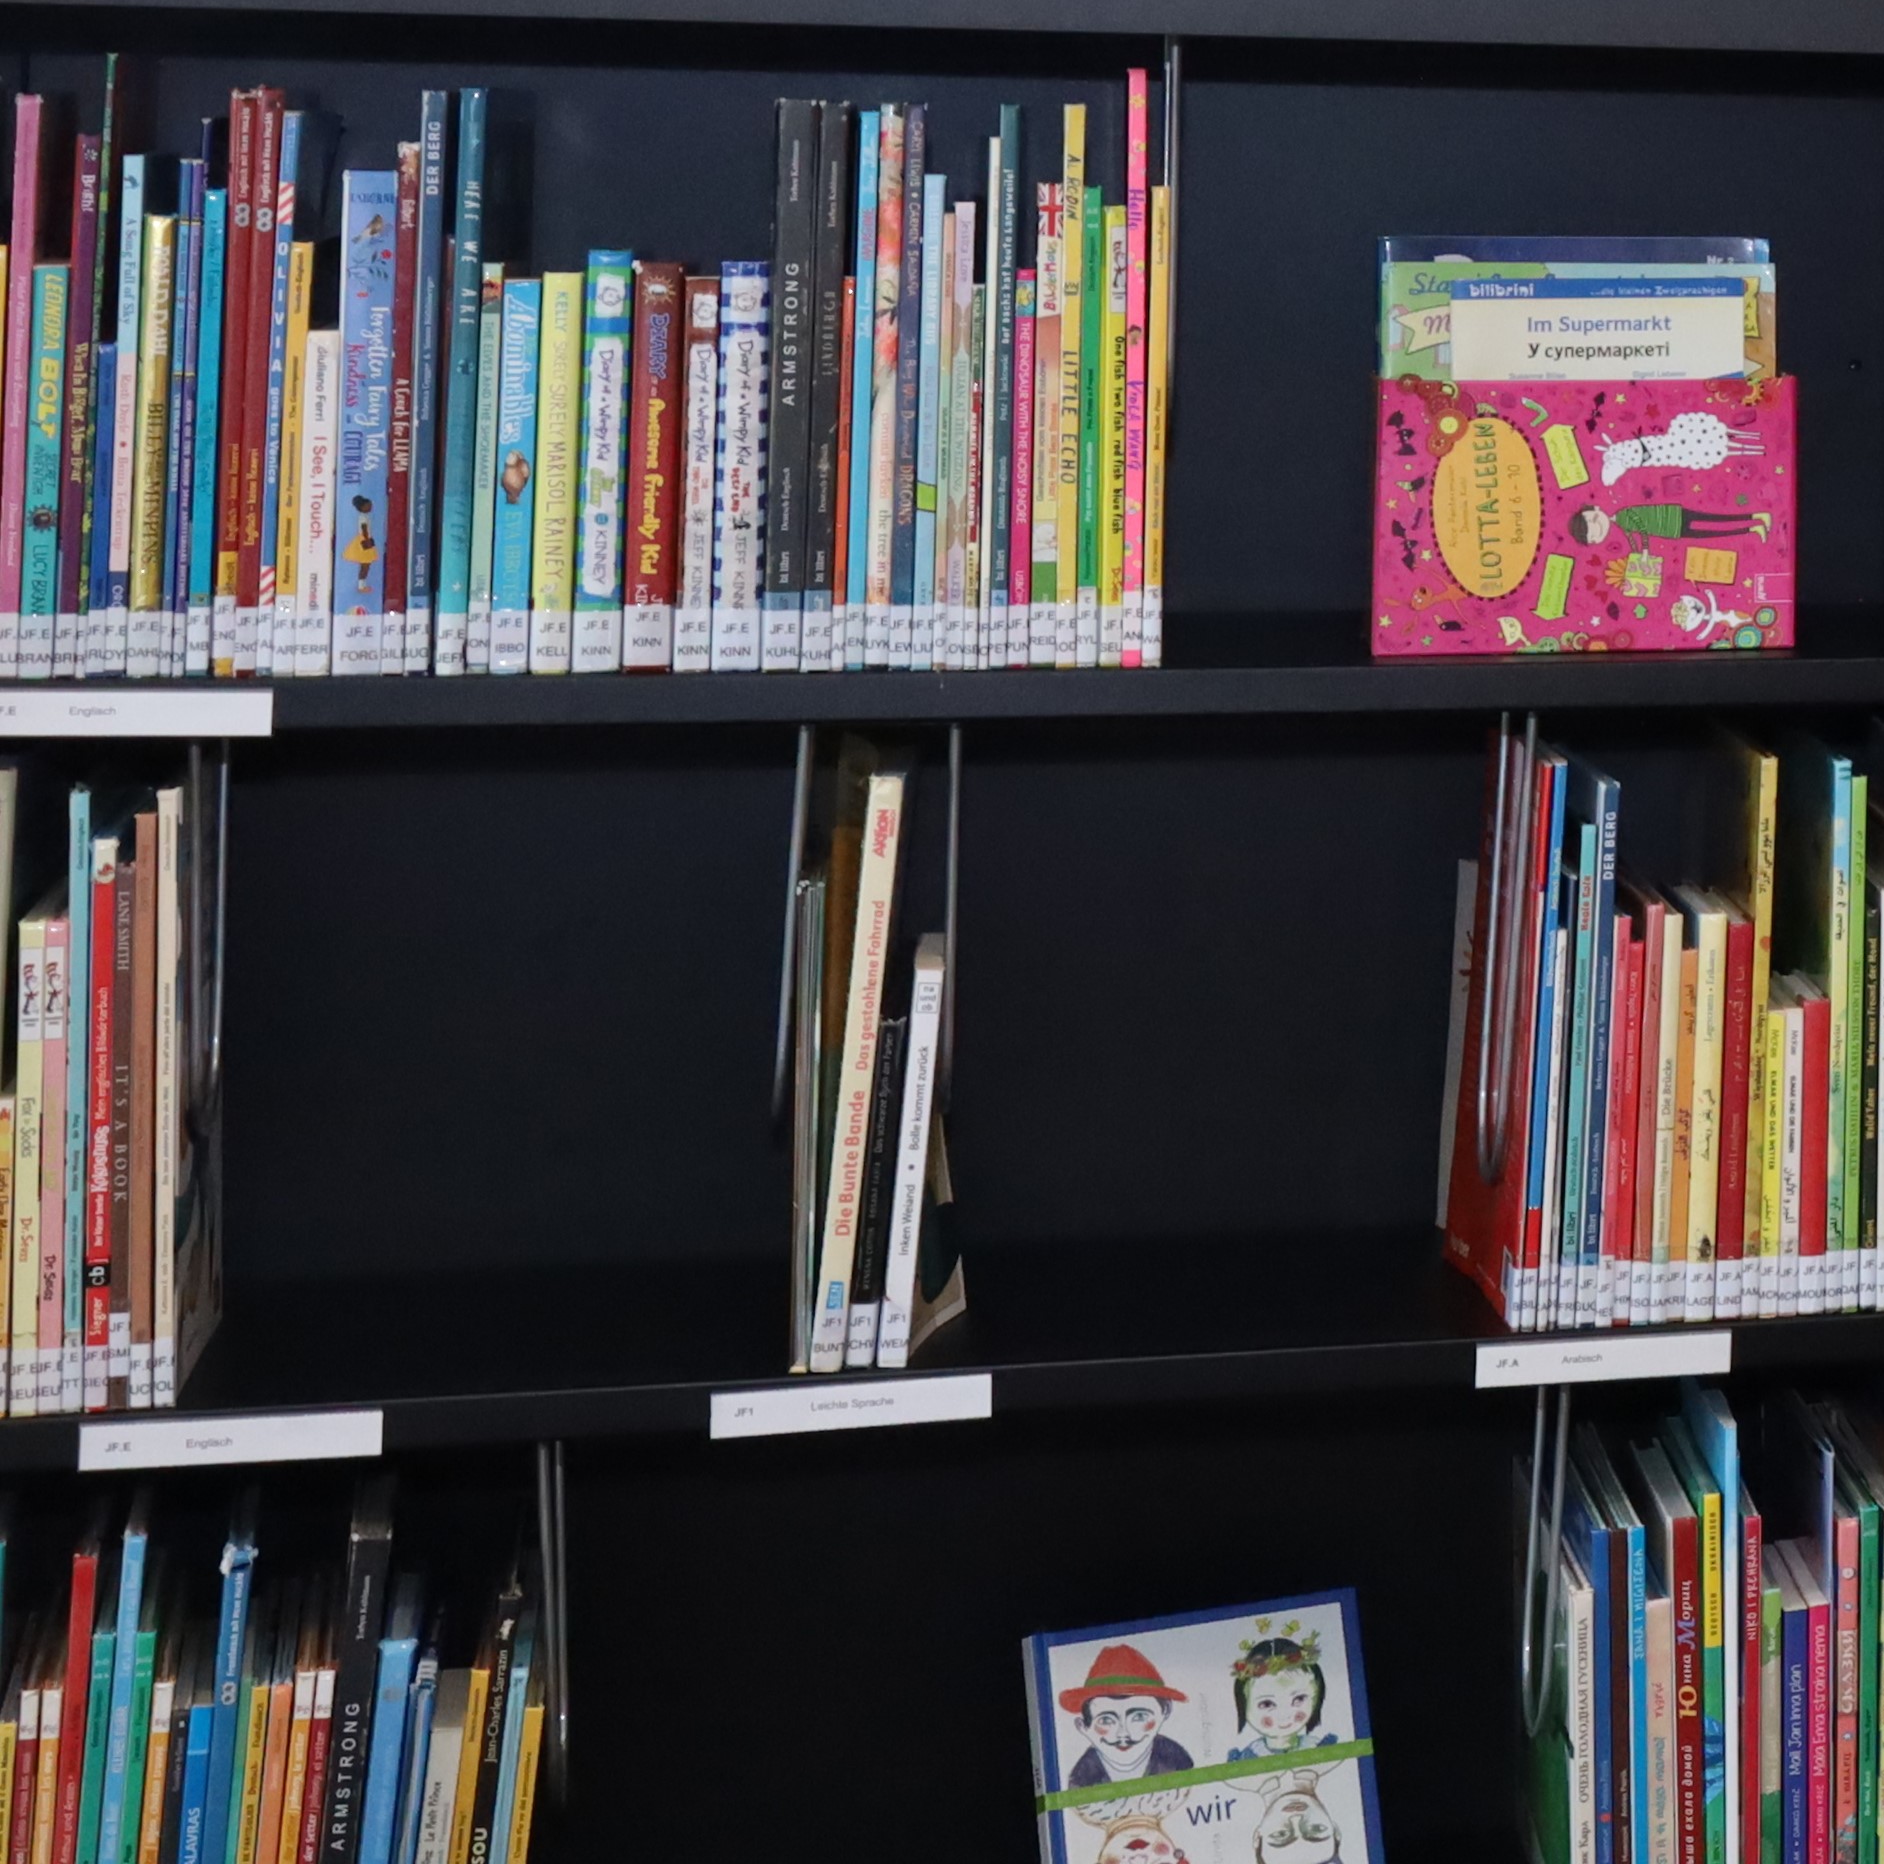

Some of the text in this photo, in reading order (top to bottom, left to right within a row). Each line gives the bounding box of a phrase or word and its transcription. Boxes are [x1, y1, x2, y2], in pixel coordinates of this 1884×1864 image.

[426, 121, 441, 196] DER BERG
[554, 291, 569, 333] KELLY
[1469, 282, 1534, 298] bilibrini
[649, 313, 670, 380] DIARY
[782, 260, 801, 408] ARMSTRONG
[1527, 315, 1672, 336] Im Supermarkt
[1528, 342, 1670, 361] У супермаркеті
[549, 384, 568, 439] SURELY
[1016, 322, 1031, 524] THE DINOSAUR WITH THE NOISY SNORE
[1060, 351, 1078, 485] LITTLE ECHO
[544, 441, 567, 513] MARISOL
[639, 398, 666, 575] Awesome Friendly Kid
[1474, 422, 1504, 581] LOTTA-LEBEN
[543, 517, 566, 581] RAINEY
[1510, 514, 1525, 545] Band
[340, 649, 379, 663] FORG
[536, 644, 568, 657] KELL
[632, 636, 662, 648] KINN
[68, 704, 118, 718] Englisch
[855, 900, 885, 1071] Das gestohlene Fahrrad
[908, 1045, 929, 1151] Bolle kommt zurück
[835, 1090, 865, 1237] Die Bunte Bande
[898, 1184, 916, 1256] Inken Weiand
[1495, 1352, 1603, 1369] JF.A Arabisch
[734, 1405, 755, 1418] JF1
[851, 1392, 894, 1412] Sprache
[103, 1435, 234, 1454] JF.E Englisch
[1676, 1579, 1698, 1719] Юнна Мориц
[331, 1703, 360, 1851] ARMSTRONG
[1186, 1796, 1239, 1828] wir
